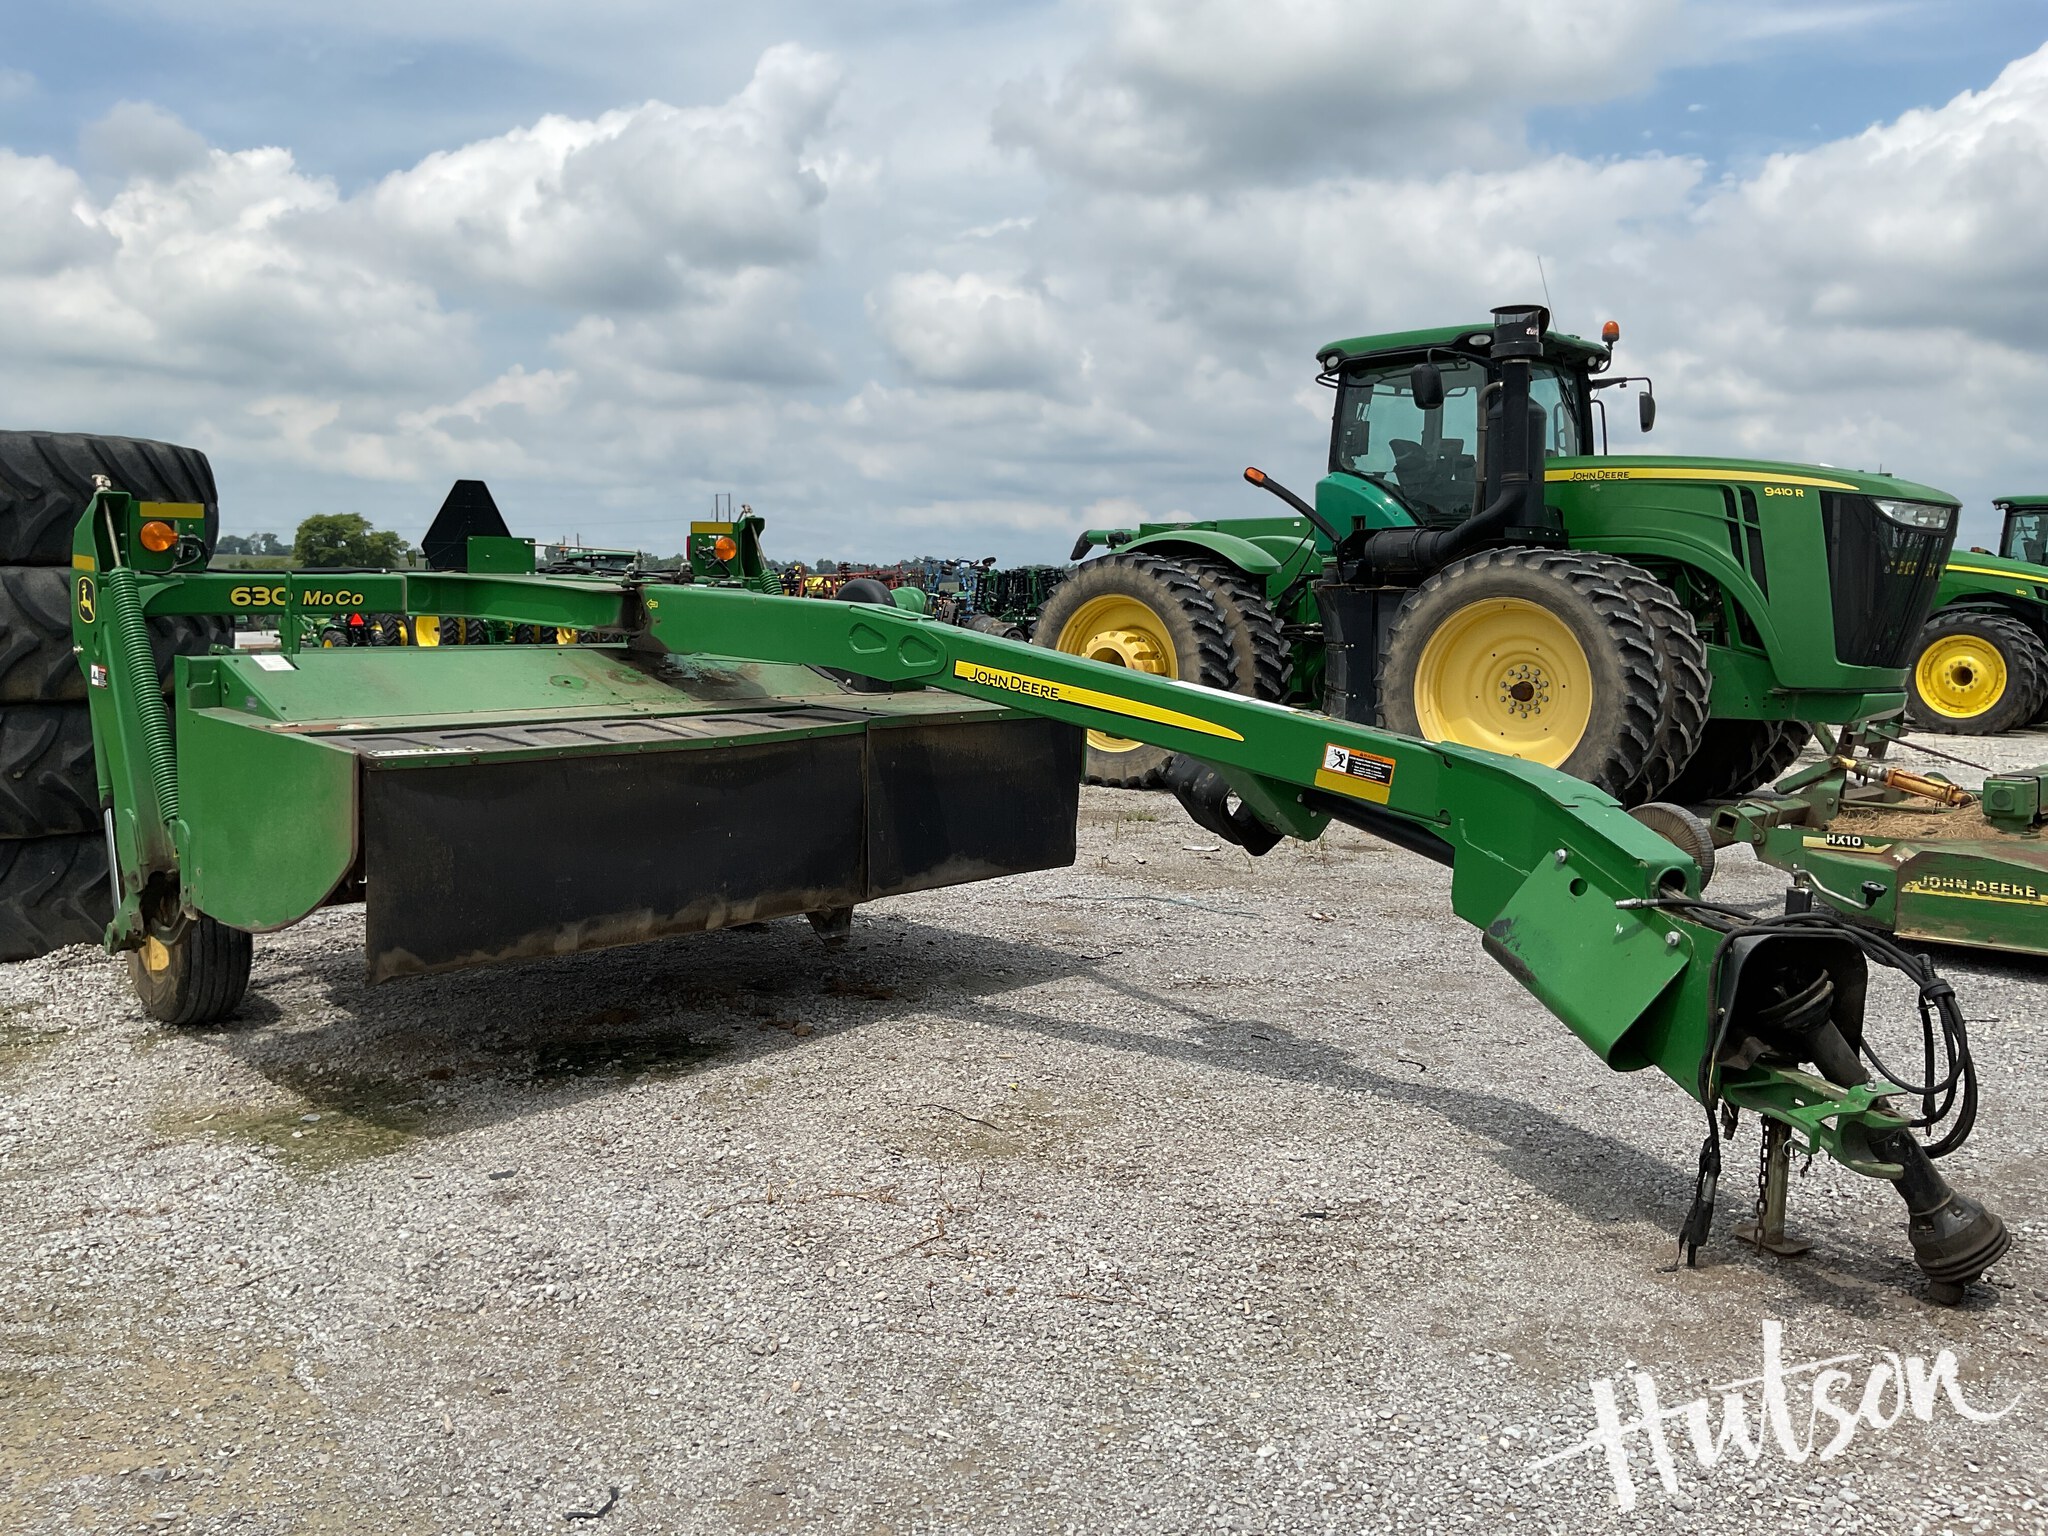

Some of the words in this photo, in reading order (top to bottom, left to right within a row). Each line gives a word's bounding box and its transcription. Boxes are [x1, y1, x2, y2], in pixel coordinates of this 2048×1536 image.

[1569, 471, 1596, 480] JOHN
[1597, 469, 1630, 479] DEERE
[1764, 486, 1793, 497] 9410
[1795, 488, 1804, 498] R
[302, 590, 364, 606] MoCo
[969, 668, 1008, 688] JOHN
[1010, 676, 1060, 699] DEERE
[1826, 833, 1862, 847] HX10
[1918, 875, 1968, 890] JOHN
[1975, 880, 2037, 898] DEERE
